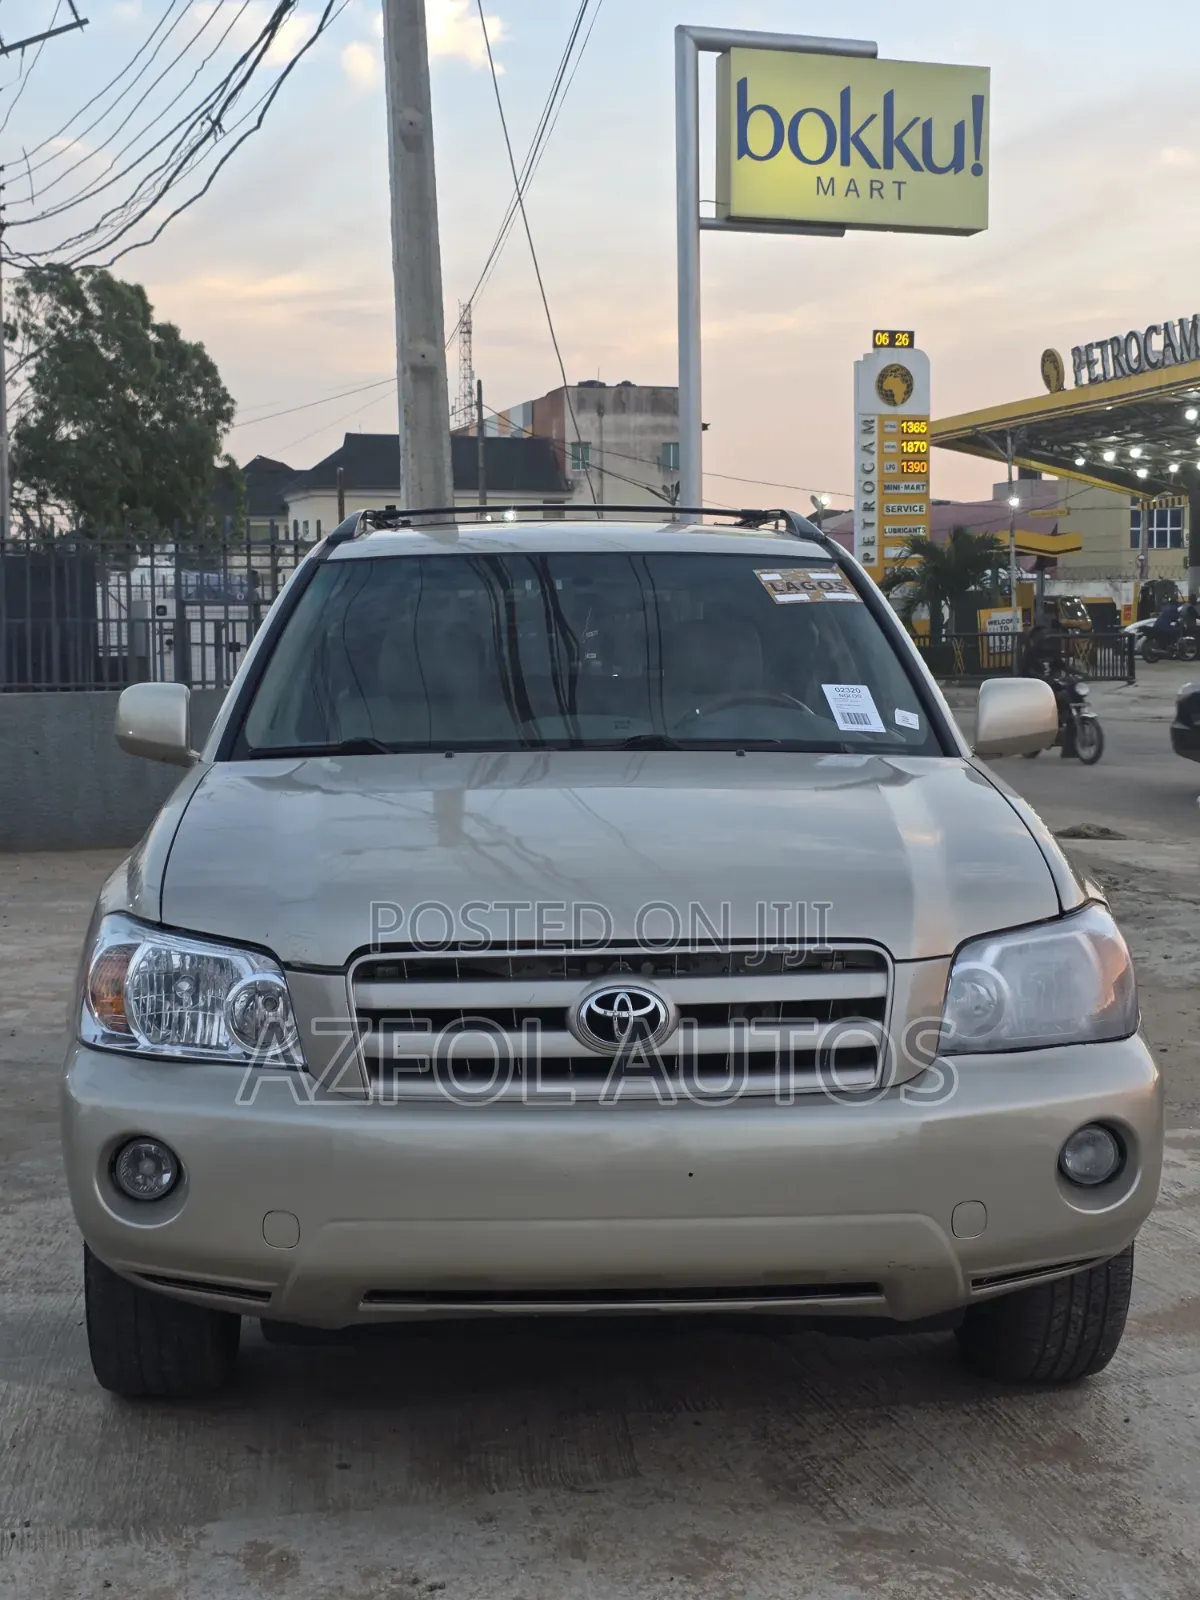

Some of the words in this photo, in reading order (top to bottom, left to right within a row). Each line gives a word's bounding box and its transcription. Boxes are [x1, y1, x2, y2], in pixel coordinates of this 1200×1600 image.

[737, 76, 984, 177] bokku!
[816, 176, 907, 200] MART
[875, 332, 889, 345] 06
[895, 333, 909, 346] 26
[901, 421, 927, 433] 1365
[901, 441, 927, 453] 1870
[901, 461, 927, 473] 1390
[861, 419, 875, 564] PETROCAM
[885, 505, 925, 513] SERVICE
[769, 581, 849, 592] LAGOS
